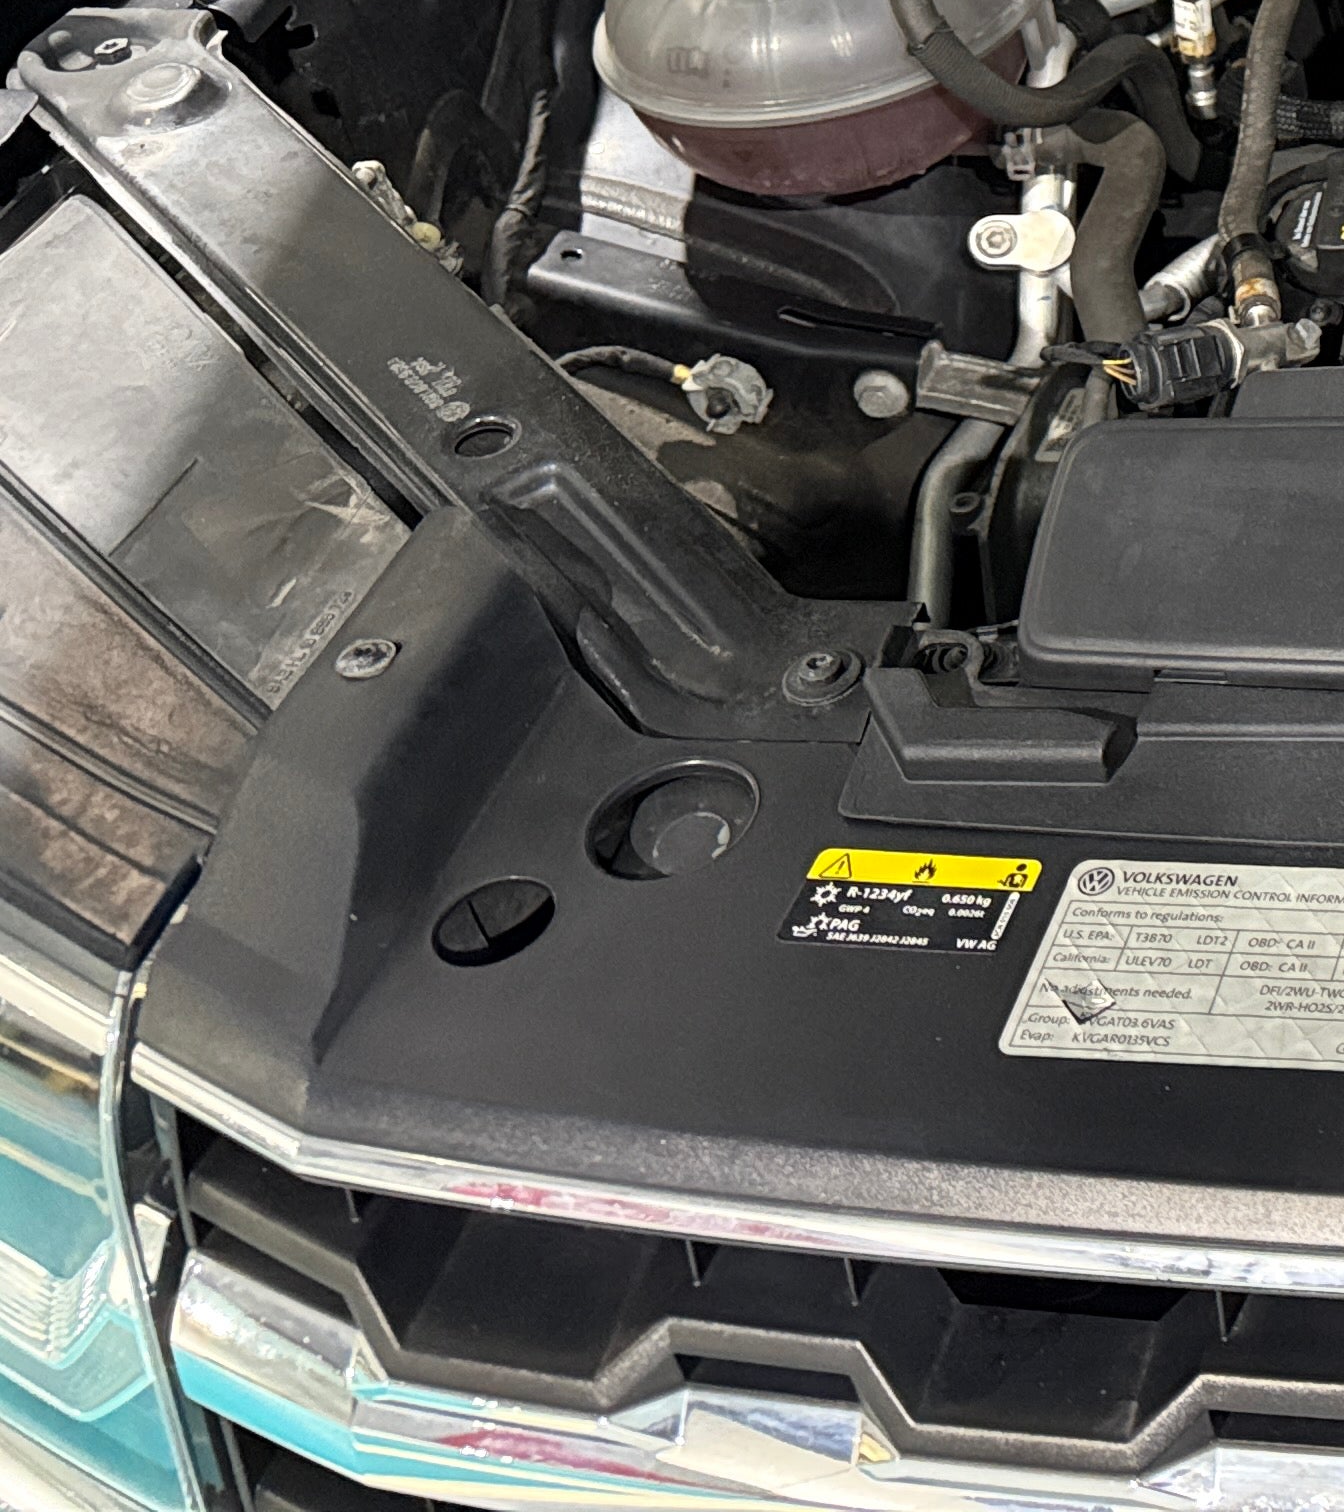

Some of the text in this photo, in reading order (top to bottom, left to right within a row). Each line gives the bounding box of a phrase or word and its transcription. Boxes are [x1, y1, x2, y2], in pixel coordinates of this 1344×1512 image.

[1122, 871, 1239, 887] VOLKSWAGEN
[847, 886, 912, 903] R-1234yf
[1117, 886, 1166, 898] VEHICLE
[1169, 887, 1230, 899] EMISSION
[1233, 890, 1293, 902] CONTROL
[942, 893, 992, 908] 0.650 kg
[1072, 906, 1224, 925] Conforms to regulations:
[829, 919, 861, 931] PAG
[826, 932, 846, 941] SAE
[1197, 934, 1229, 946] LDT2
[956, 938, 998, 951] VW AG
[1286, 939, 1306, 949] CA
[1125, 956, 1172, 968] ULEV70
[1188, 958, 1214, 969] LDT
[1278, 962, 1299, 973] CA
[1143, 989, 1192, 1000] needed.
[1027, 1012, 1071, 1026] Group:
[1020, 1029, 1054, 1042] Evap:
